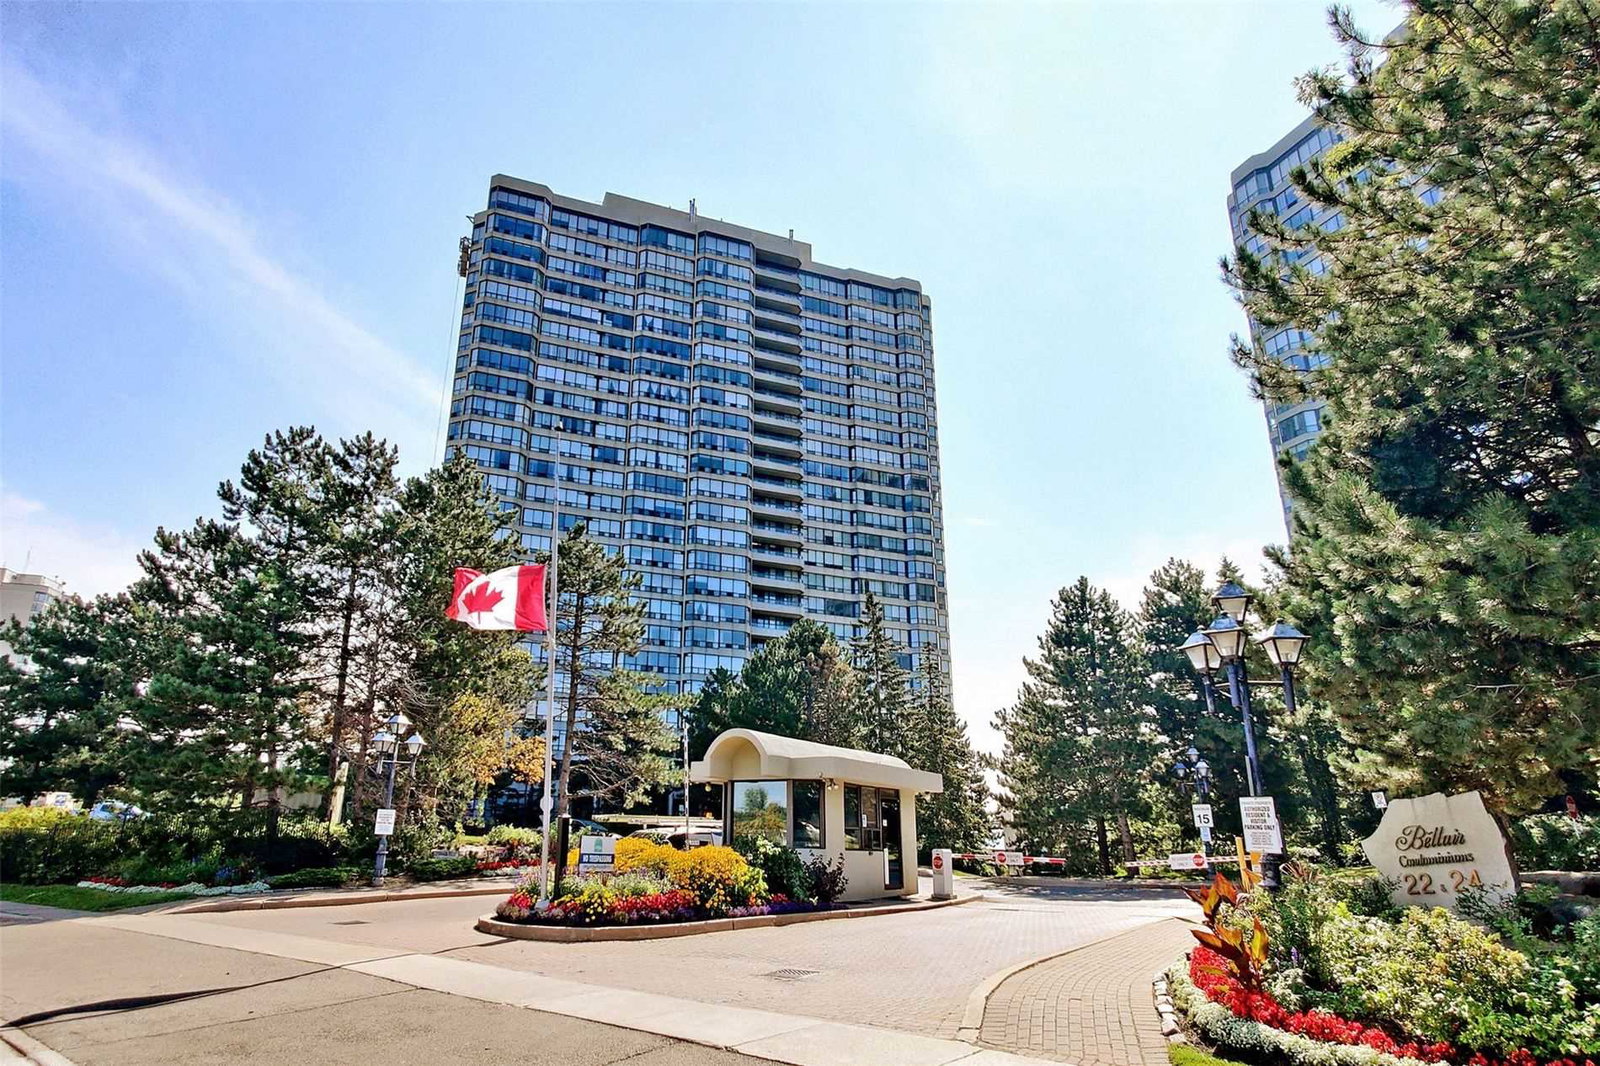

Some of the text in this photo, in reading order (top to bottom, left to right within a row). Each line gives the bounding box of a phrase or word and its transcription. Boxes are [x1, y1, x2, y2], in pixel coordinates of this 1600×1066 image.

[1196, 813, 1210, 824] 15
[1399, 852, 1475, 868] Condominiums
[1403, 873, 1436, 895] 22
[1448, 869, 1482, 893] 24
